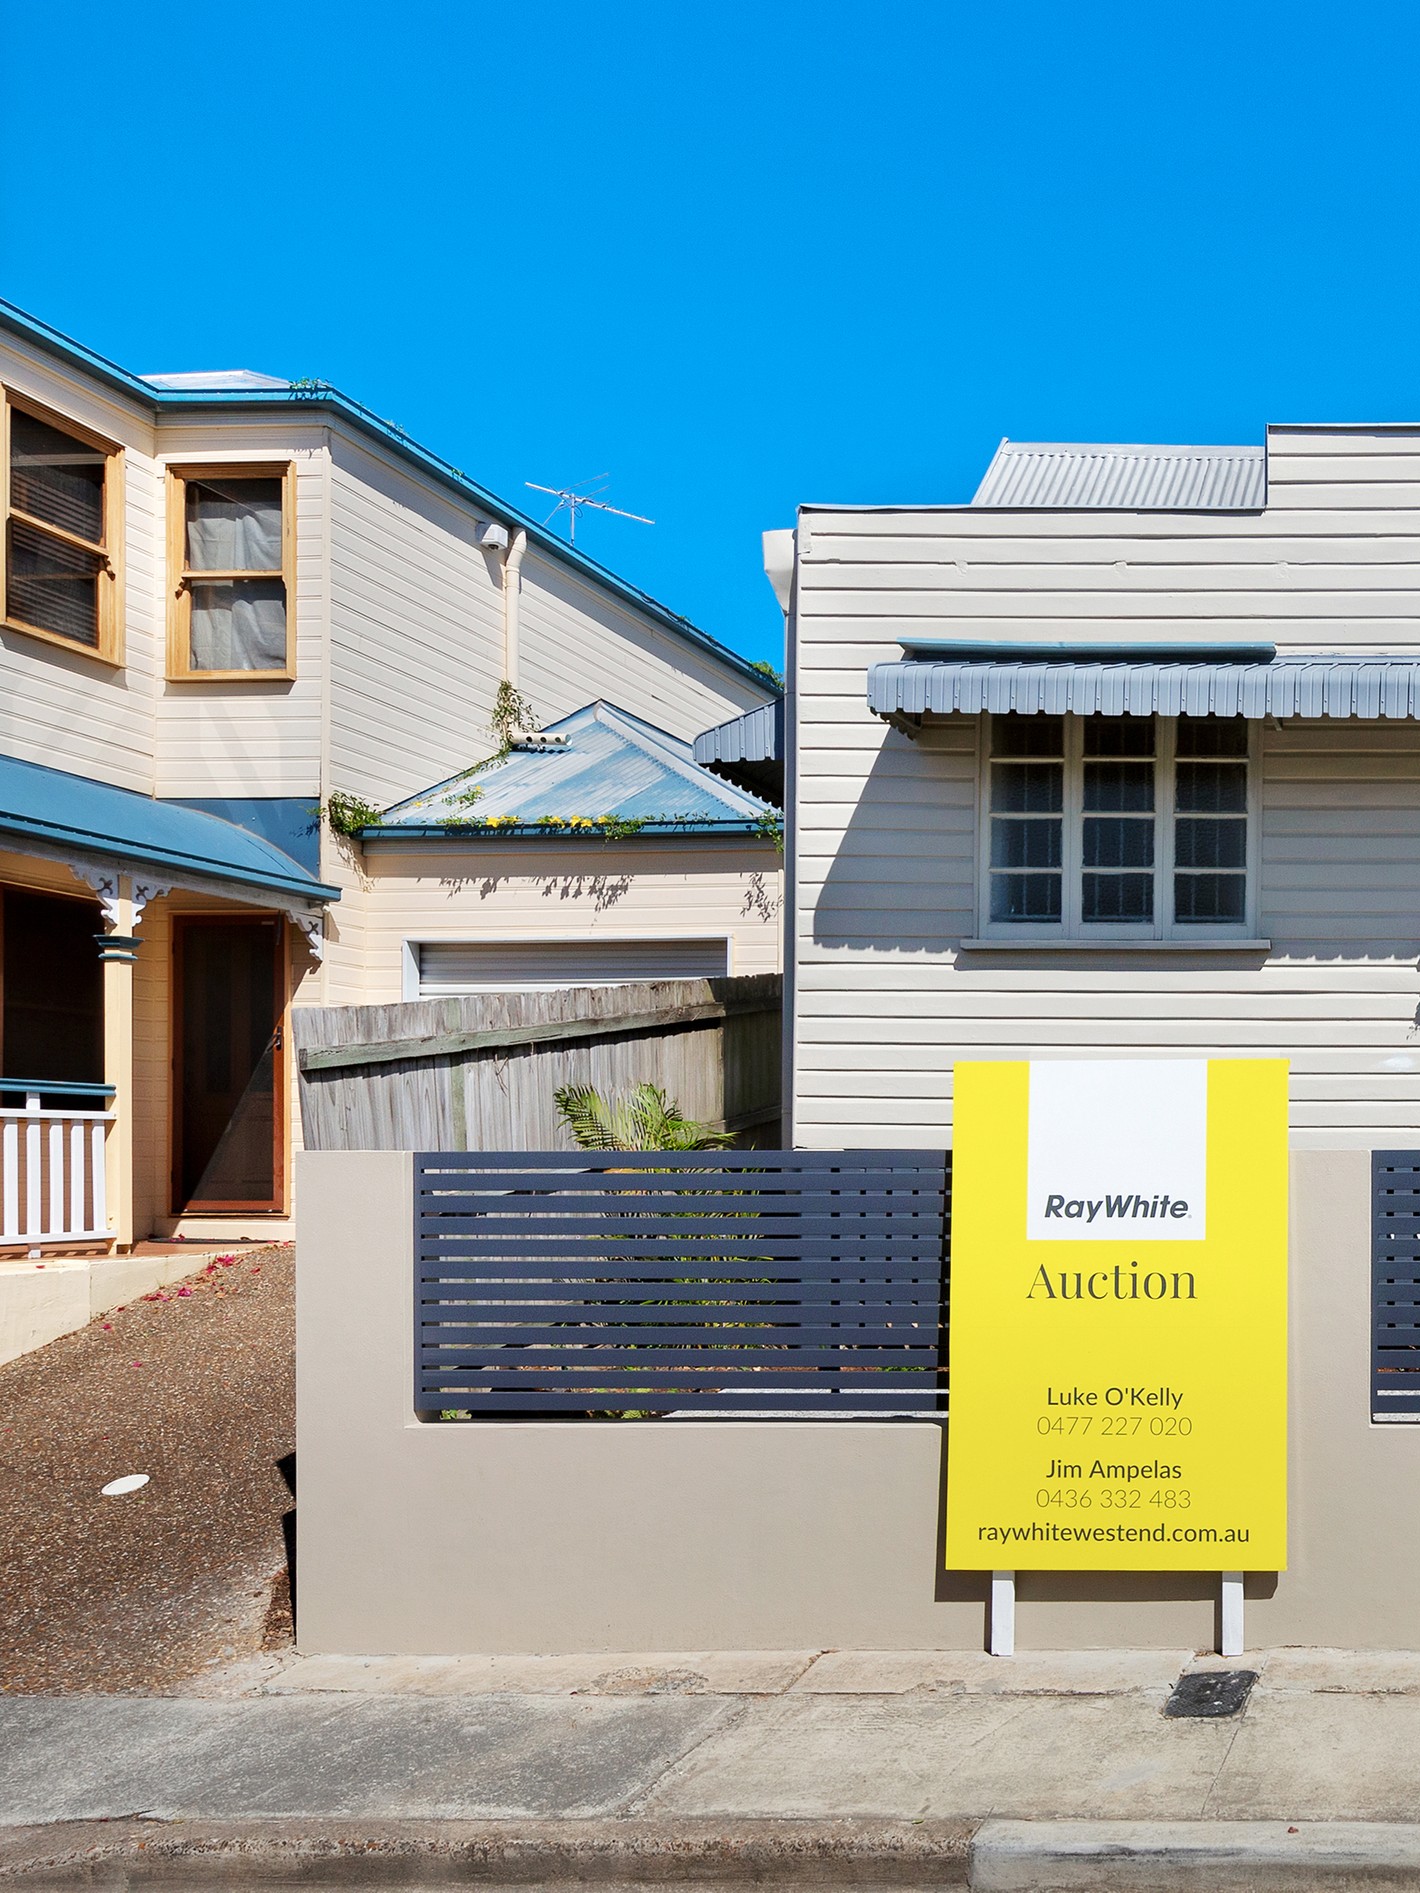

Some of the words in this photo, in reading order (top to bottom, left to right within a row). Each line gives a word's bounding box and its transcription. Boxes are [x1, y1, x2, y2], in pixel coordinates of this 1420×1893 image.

[1026, 1260, 1198, 1300] Auction
[1047, 1386, 1098, 1406] Luke
[1104, 1386, 1184, 1411] O'Kelly
[1037, 1416, 1093, 1436] 0477
[1101, 1416, 1143, 1436] 227
[1149, 1416, 1193, 1436] 020
[1045, 1459, 1082, 1479] Jim
[1088, 1459, 1182, 1483] Ampelas
[1036, 1488, 1093, 1509] 0436
[1100, 1488, 1141, 1509] 332
[1148, 1488, 1191, 1509] 483
[978, 1521, 1250, 1545] raywhitewestend.com.au
